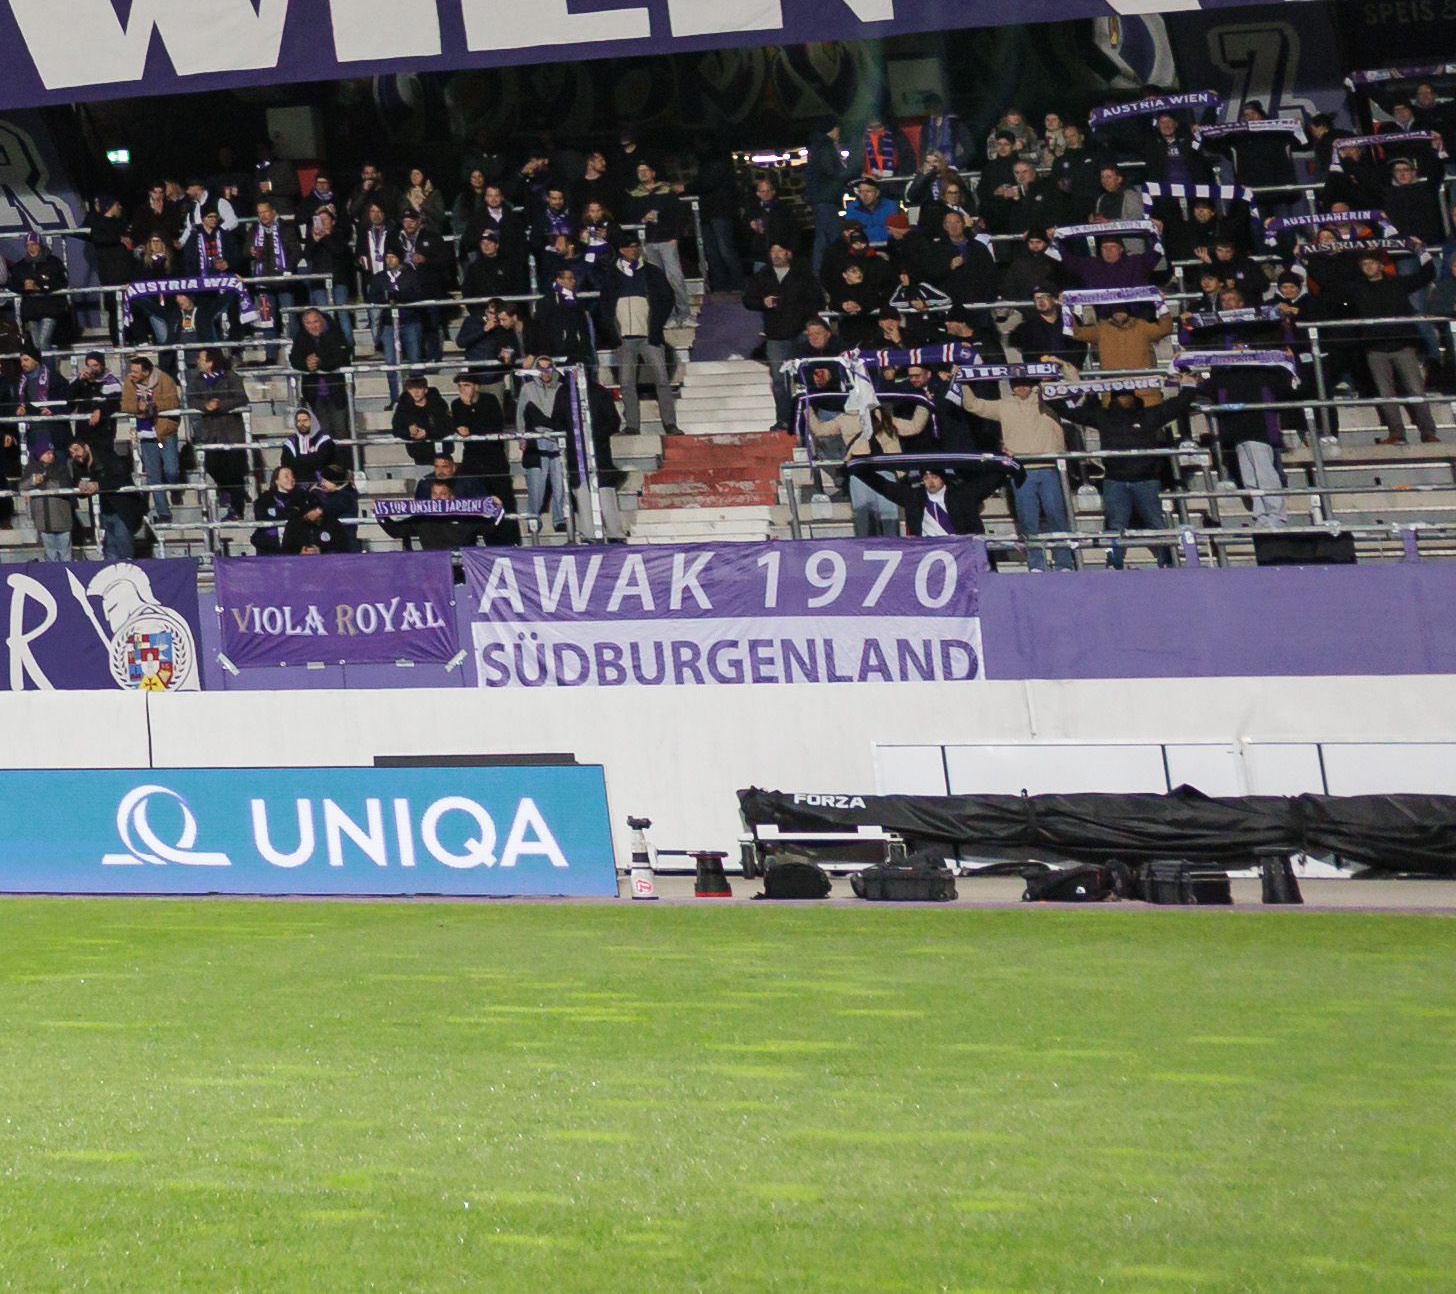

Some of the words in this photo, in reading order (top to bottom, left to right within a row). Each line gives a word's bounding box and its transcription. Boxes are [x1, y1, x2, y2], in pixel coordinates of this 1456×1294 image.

[1102, 98, 1165, 119] AUSTRIA
[1168, 91, 1209, 106] WIEN
[1303, 242, 1365, 256] AUSTRIA
[1366, 239, 1408, 251] WIEN
[127, 279, 198, 300] AUSTRIA
[478, 549, 717, 613] AWAK
[757, 548, 958, 609] 1970
[233, 606, 325, 638] VIOLA
[336, 600, 446, 637] ROYAL
[482, 630, 980, 688] SÜDBURGENLAND
[793, 791, 867, 809] FORZA
[251, 797, 570, 868] UNIQA
